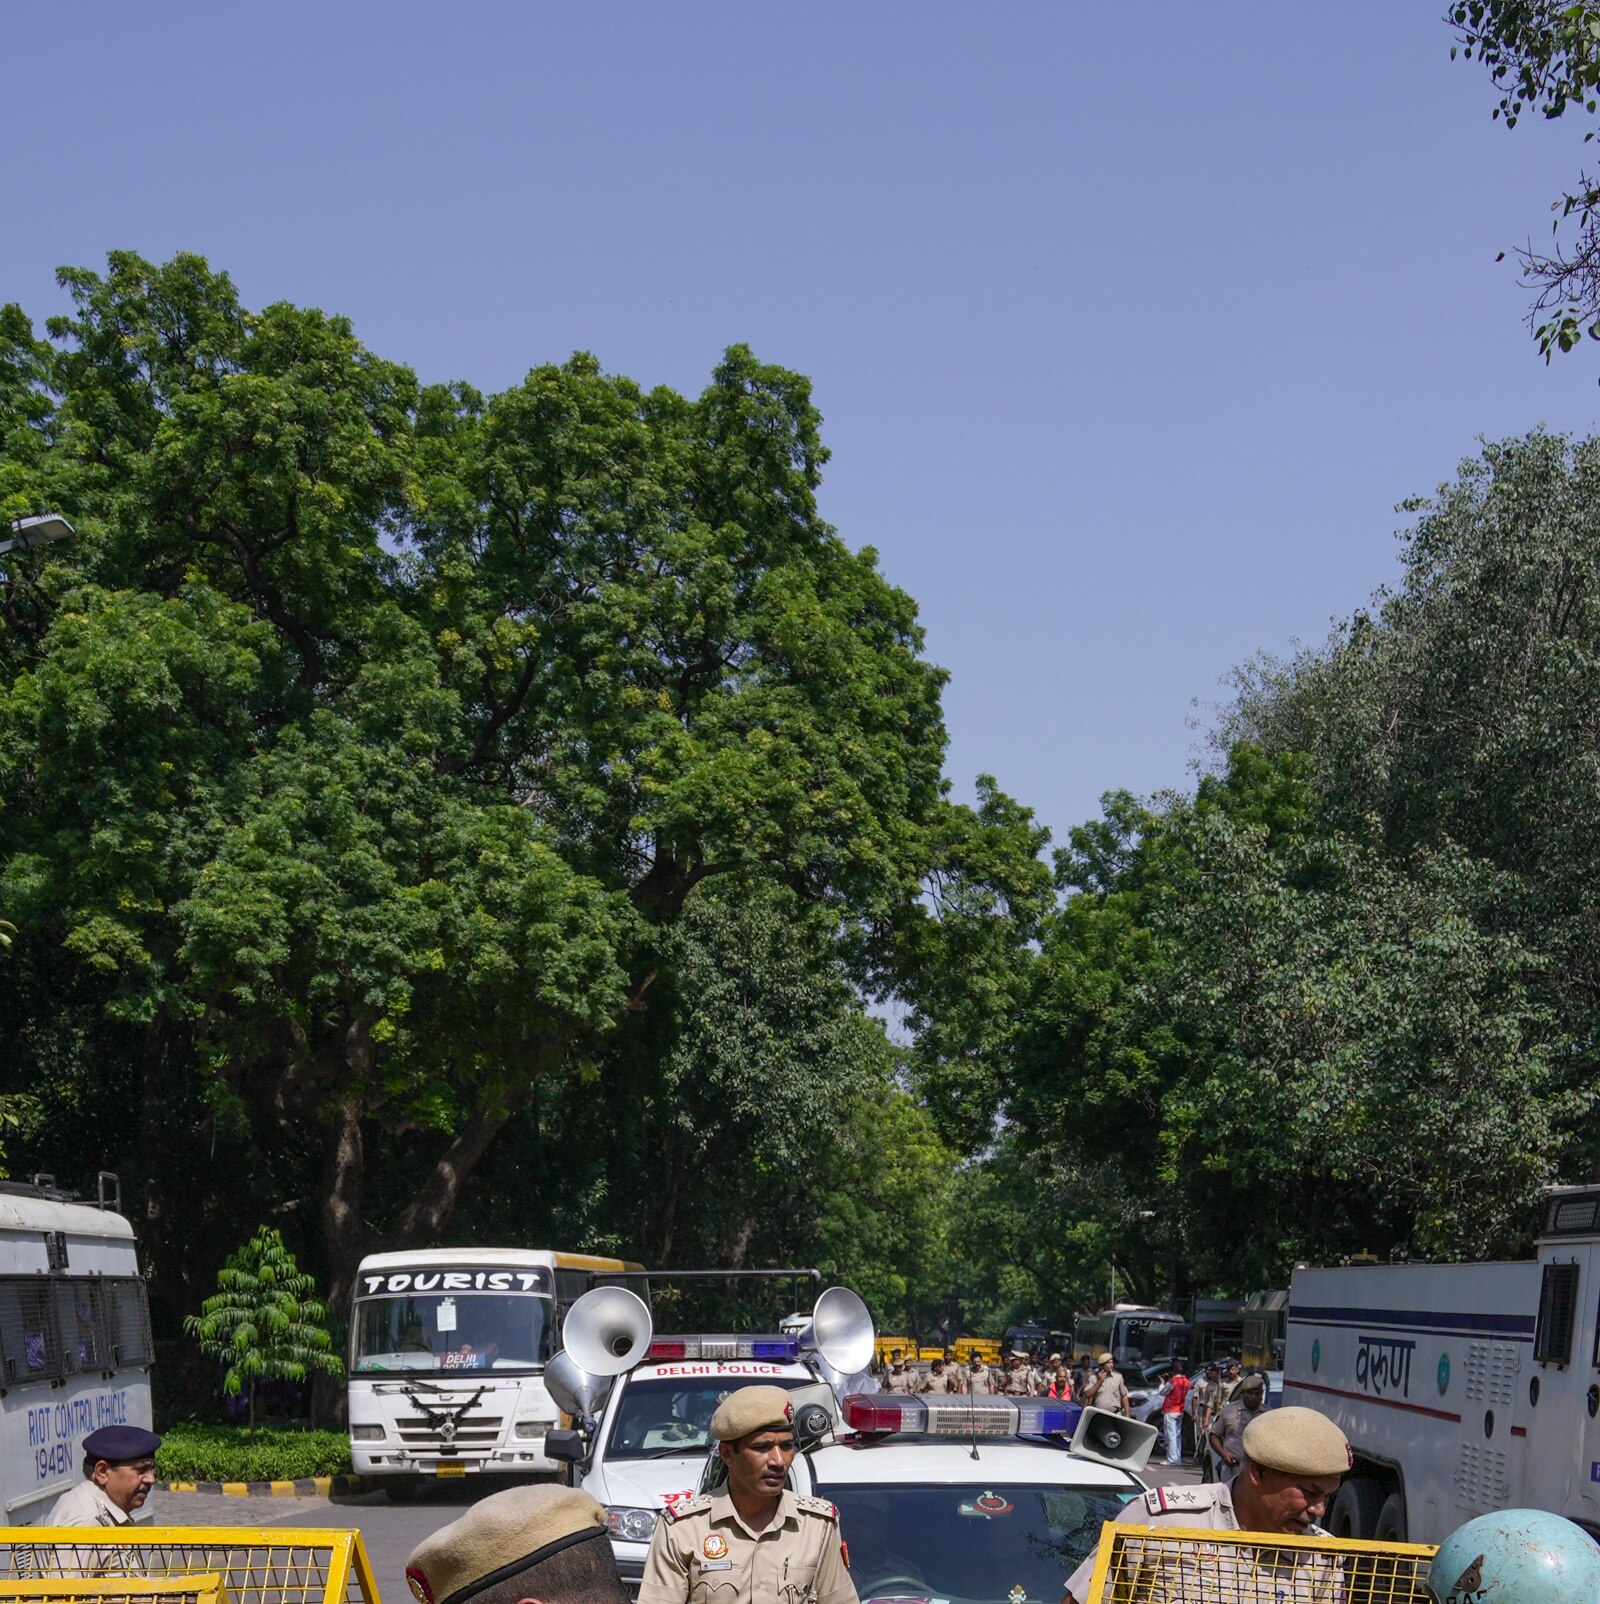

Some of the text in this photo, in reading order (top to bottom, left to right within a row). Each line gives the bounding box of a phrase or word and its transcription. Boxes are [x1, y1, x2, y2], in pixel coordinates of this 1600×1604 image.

[365, 1272, 540, 1294] TOURIST
[446, 1354, 476, 1365] DELHI
[657, 1365, 783, 1376] DELHI POLICE
[28, 1392, 127, 1447] RIOT CONTROL VEHICLE
[35, 1441, 73, 1480] 194BN
